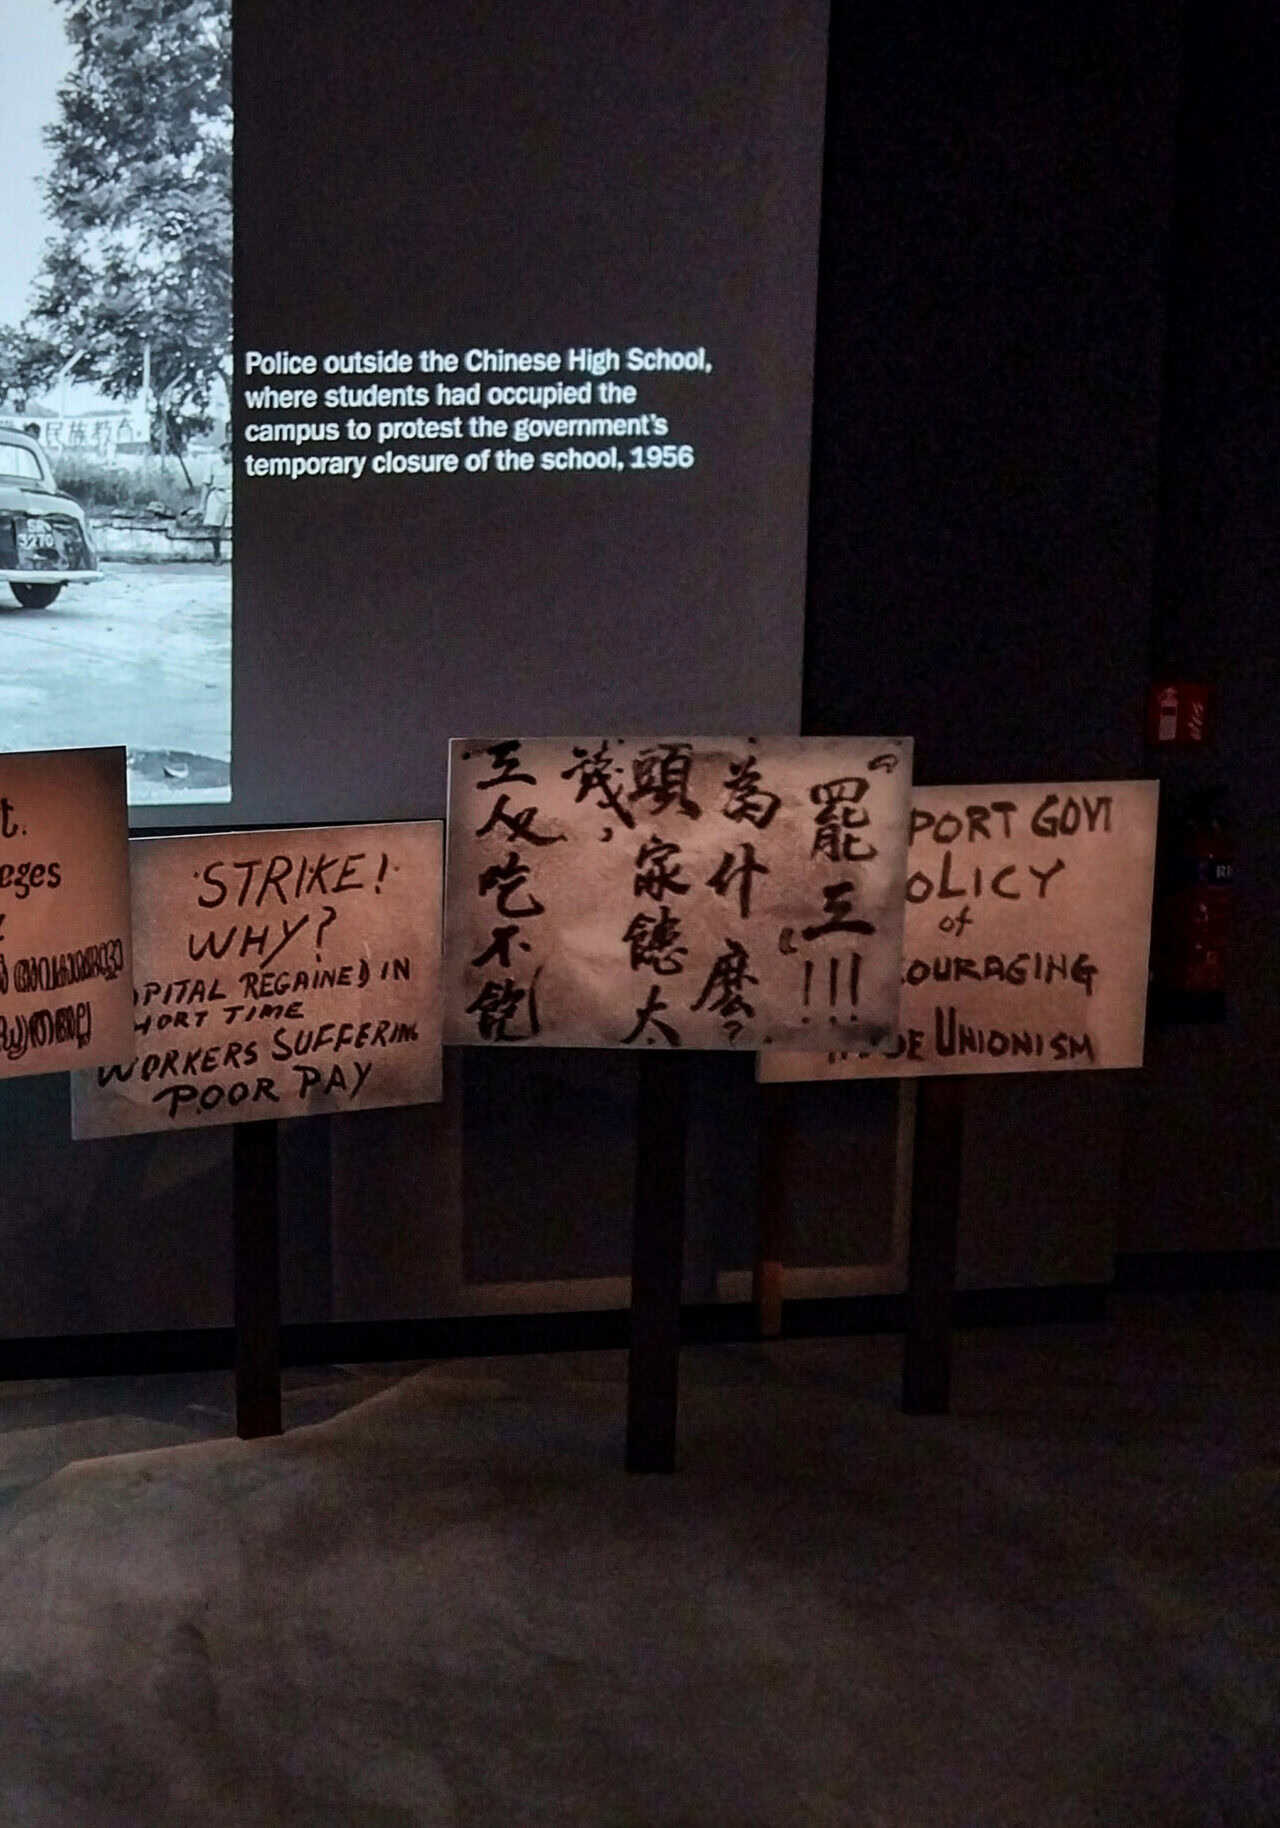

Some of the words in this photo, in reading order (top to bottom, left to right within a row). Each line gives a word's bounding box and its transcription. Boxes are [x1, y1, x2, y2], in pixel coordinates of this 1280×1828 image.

[245, 351, 317, 375] Police
[323, 349, 413, 375] outside
[419, 349, 459, 374] the
[464, 347, 561, 373] Chinese
[568, 347, 620, 376] High
[626, 347, 713, 375] School,
[245, 386, 318, 409] where
[324, 384, 430, 408] students
[435, 383, 481, 407] had
[487, 381, 592, 409] occupied
[597, 381, 638, 405] the
[245, 421, 339, 446] campus
[345, 418, 372, 442] to
[377, 416, 463, 444] protest
[468, 415, 508, 440] the
[513, 412, 669, 442] government's
[245, 452, 366, 480] temporary
[371, 450, 459, 474] closure
[464, 447, 491, 472] of
[495, 448, 534, 472] the
[540, 446, 624, 474] school,
[630, 444, 695, 470] 1956
[197, 853, 389, 908] STRIKE!
[188, 905, 337, 969] WHY?
[939, 905, 975, 937] of
[238, 958, 370, 1000] REGAINED
[381, 957, 410, 982] IN
[901, 953, 1099, 996] OURAGING
[223, 1001, 304, 1025] TIME
[933, 1005, 1095, 1064] UNIONISM
[98, 1040, 259, 1088] WORKERS
[152, 1076, 281, 1119] POOR
[292, 1060, 373, 1099] PAY
